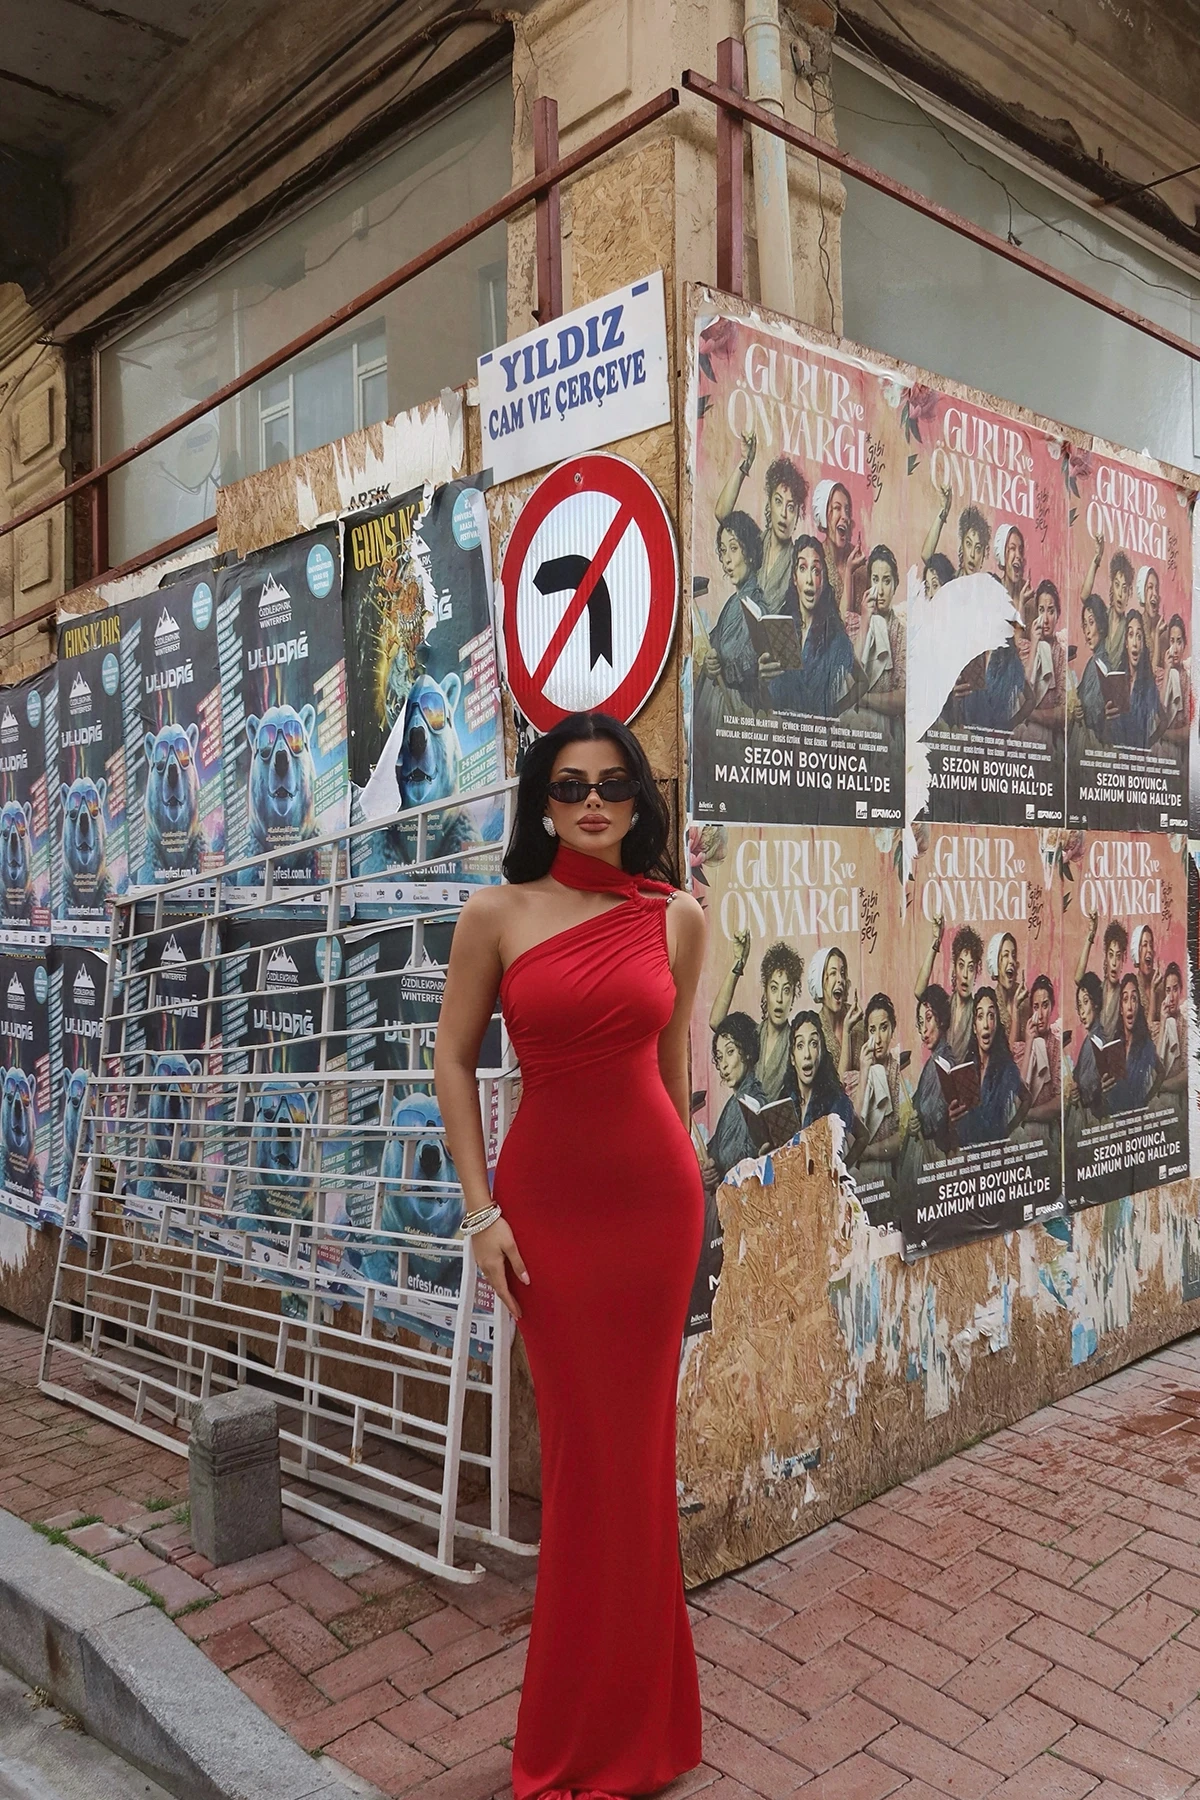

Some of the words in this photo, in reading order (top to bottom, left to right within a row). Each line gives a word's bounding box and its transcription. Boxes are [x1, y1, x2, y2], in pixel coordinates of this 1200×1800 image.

[500, 304, 625, 392] YILDIZ
[488, 398, 524, 440] CAM
[528, 387, 551, 424] VE
[555, 349, 646, 421] ÇERÇEVE
[745, 343, 851, 423] GURUR
[848, 401, 865, 421] ve
[728, 379, 866, 476] ÖNYARGI
[943, 407, 1023, 474] GURUR
[1021, 454, 1034, 472] ve
[931, 439, 1036, 519] ÖNYARGI
[1096, 465, 1158, 521] GURUR
[1156, 502, 1167, 519] ve
[351, 513, 397, 572] GUNS
[1086, 493, 1168, 560] ÖNYARGI
[259, 612, 292, 629] WINTERFEST
[714, 764, 791, 787] MAXIMUM
[796, 770, 832, 790] UNIQ
[837, 774, 891, 793] HALL'DE
[744, 746, 794, 767] SEZON
[799, 751, 868, 773] BOYUNCA
[942, 757, 980, 774] SEZON
[983, 760, 1035, 780] BOYUNCA
[1096, 773, 1126, 788] SEZON
[1128, 776, 1168, 792] BOYUNCA
[926, 773, 978, 791] AXIMUM
[981, 776, 1008, 794] UNIQ
[1011, 779, 1053, 797] HALL'DE
[1079, 787, 1124, 803] MAXIMUM
[1126, 790, 1147, 805] UNIQ
[1149, 792, 1182, 807] HALL'DE
[735, 839, 842, 889] GURUR
[840, 861, 856, 880] ve
[934, 834, 1015, 879] GURUR
[1013, 858, 1026, 875] ve
[1088, 840, 1151, 879] GURUR
[1149, 858, 1161, 873] ve
[721, 881, 860, 941] ÖNYARGI
[921, 871, 1028, 921] ÖNYARGI
[1079, 871, 1161, 919] ÖNYARGI
[1077, 1157, 1122, 1182] MAXIMUM
[1123, 1153, 1145, 1171] UNIQ
[1147, 1140, 1181, 1160] HALL'DE
[1093, 1141, 1123, 1162] SEZON
[1125, 1130, 1166, 1153] BOYUNCA
[917, 1196, 975, 1224] MAXIMUM
[977, 1189, 1006, 1208] UNIQ
[1008, 1176, 1051, 1200] HALL'DE
[938, 1176, 977, 1200] SEZON
[979, 1165, 1033, 1189] BOYUNCA
